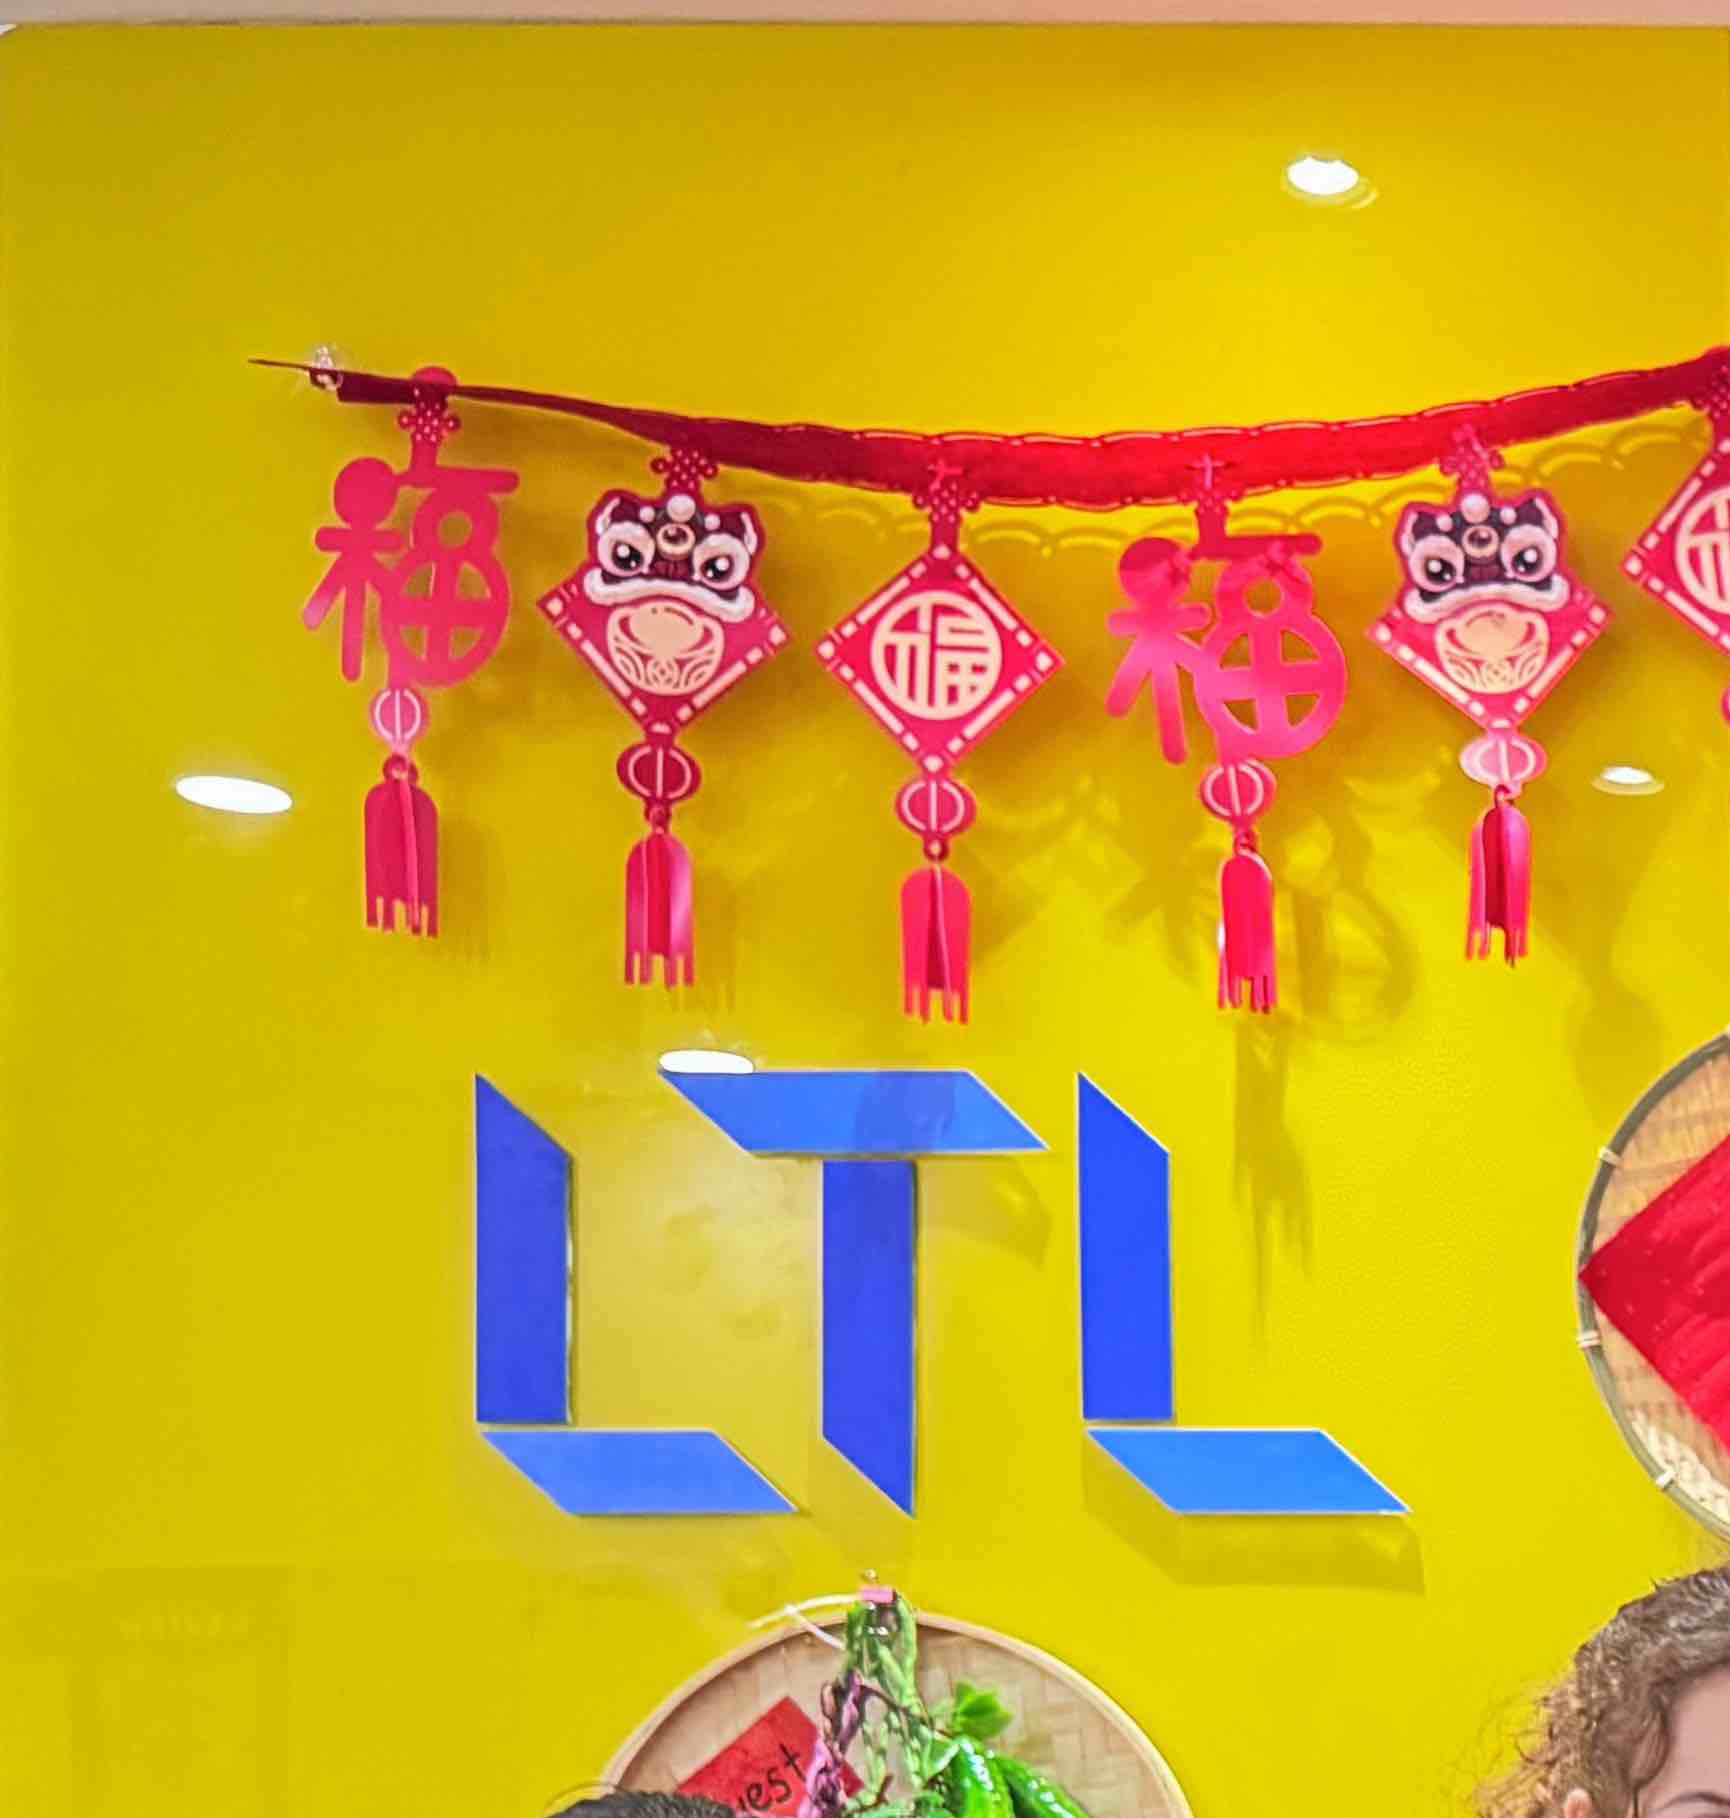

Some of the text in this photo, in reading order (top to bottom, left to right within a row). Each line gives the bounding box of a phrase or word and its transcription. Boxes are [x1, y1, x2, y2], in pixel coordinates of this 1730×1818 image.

[300, 456, 520, 689] 福
[870, 590, 1002, 720] 福
[1105, 531, 1348, 766] 福
[475, 1068, 1412, 1519] LTL
